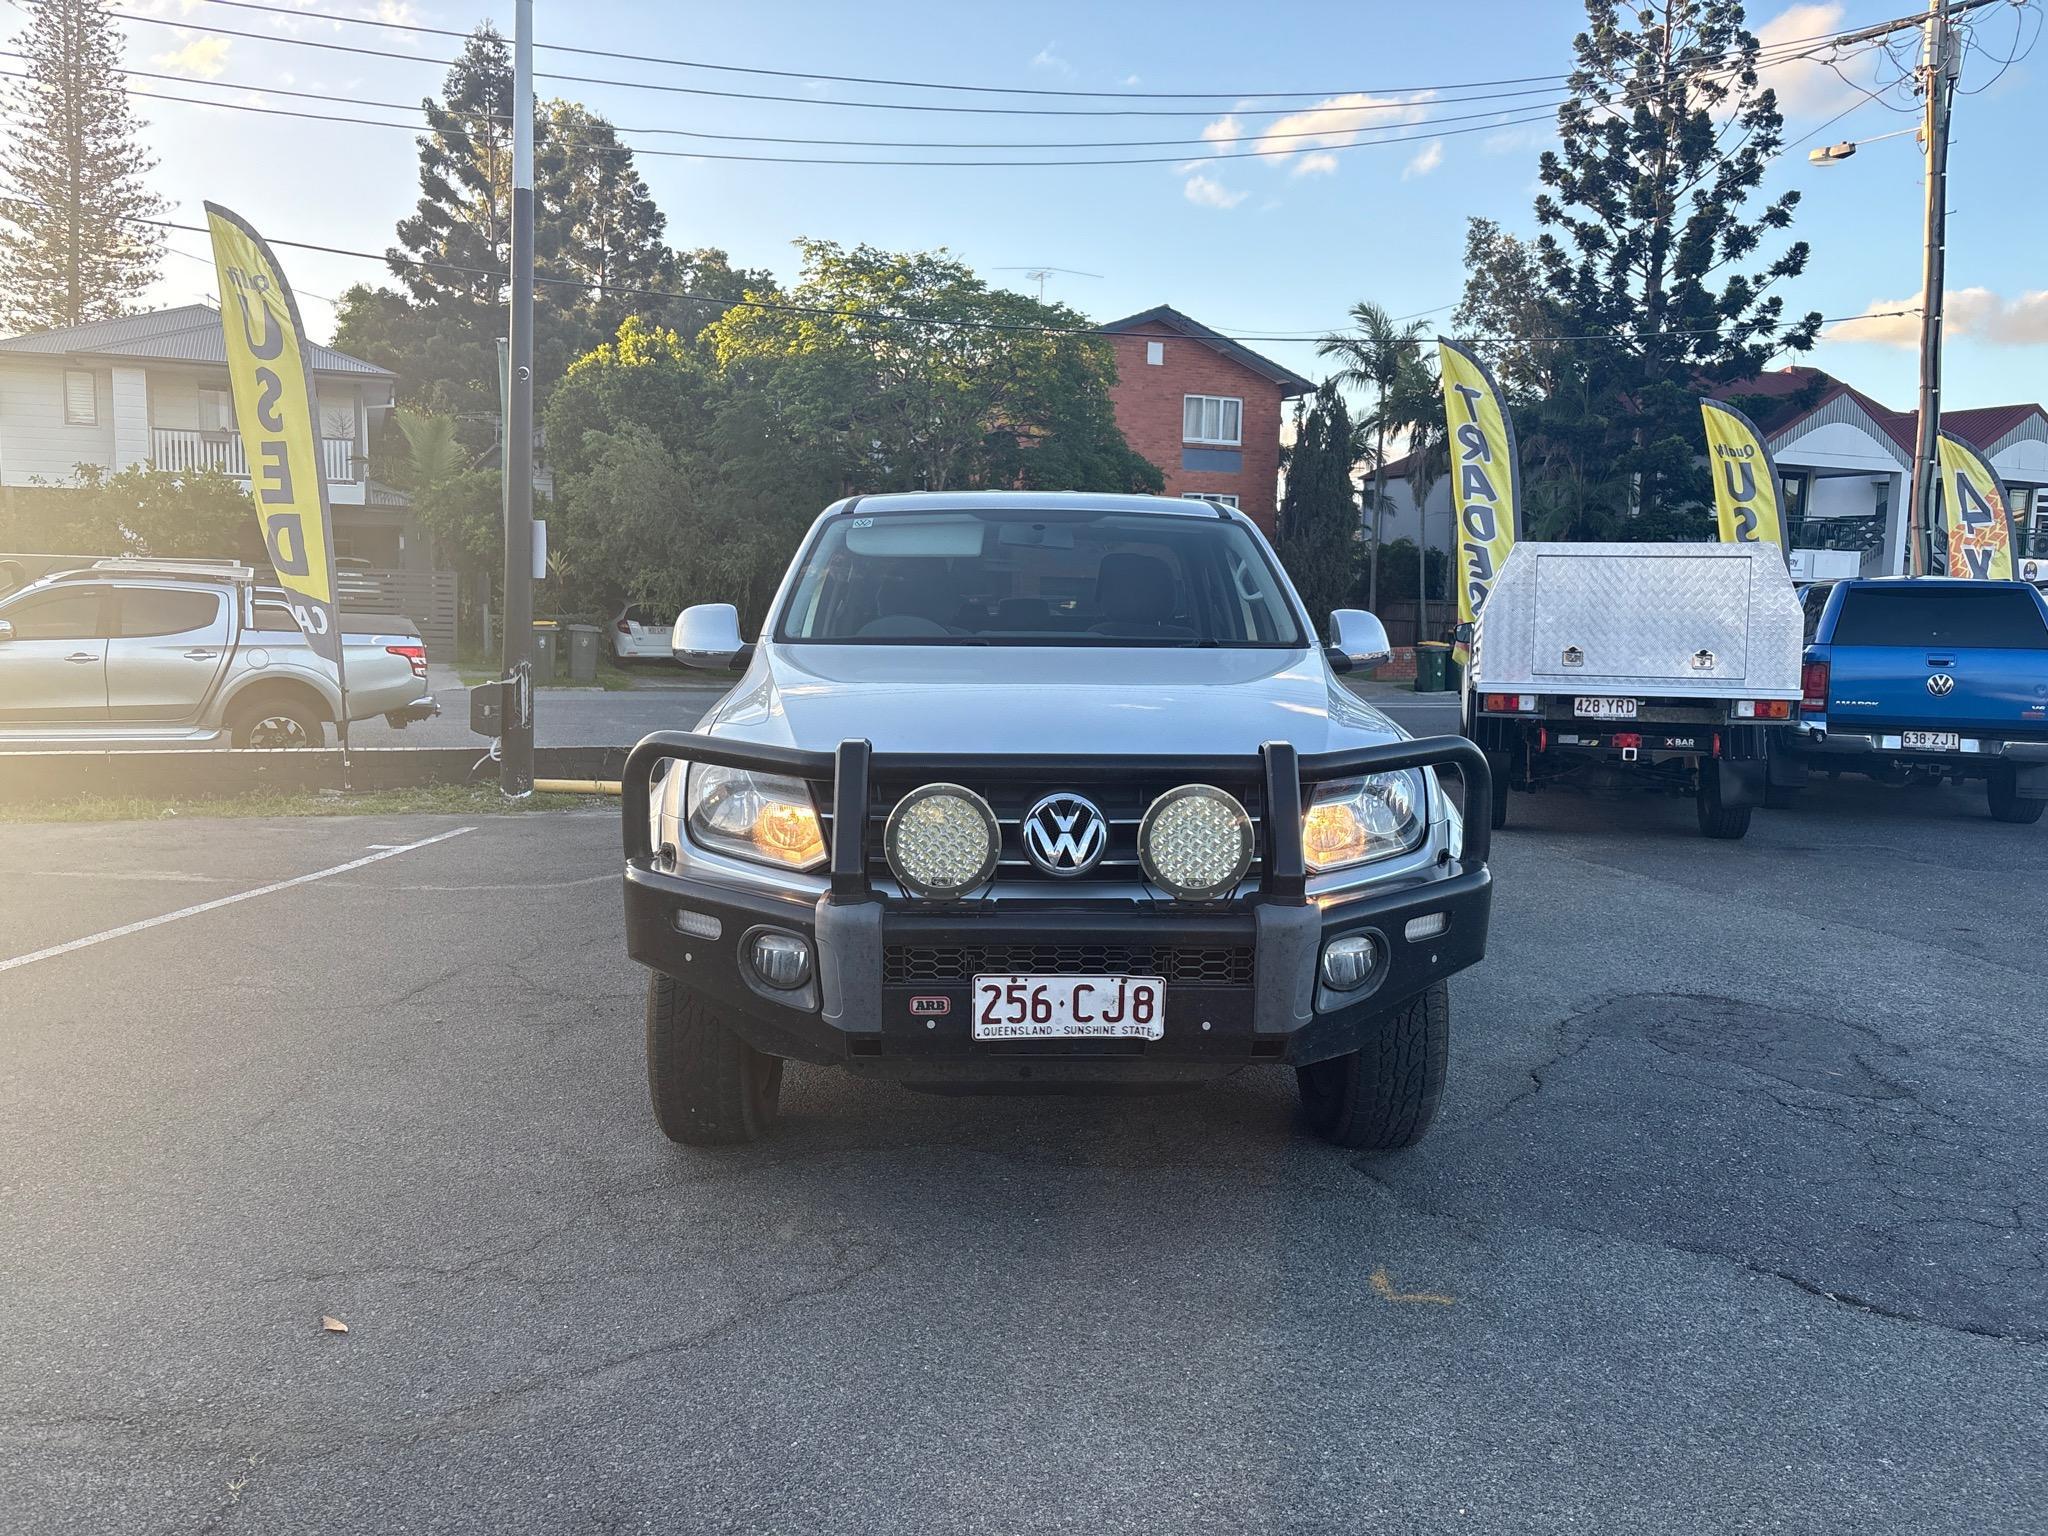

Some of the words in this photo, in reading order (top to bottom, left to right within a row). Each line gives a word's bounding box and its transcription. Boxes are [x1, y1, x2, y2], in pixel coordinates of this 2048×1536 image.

[1675, 738, 1695, 746] BAR
[915, 1000, 946, 1011] ARB
[983, 1026, 1053, 1036] QUEENSLAND
[1064, 1026, 1116, 1035] SUNSHINE
[1122, 1026, 1153, 1037] STATE
